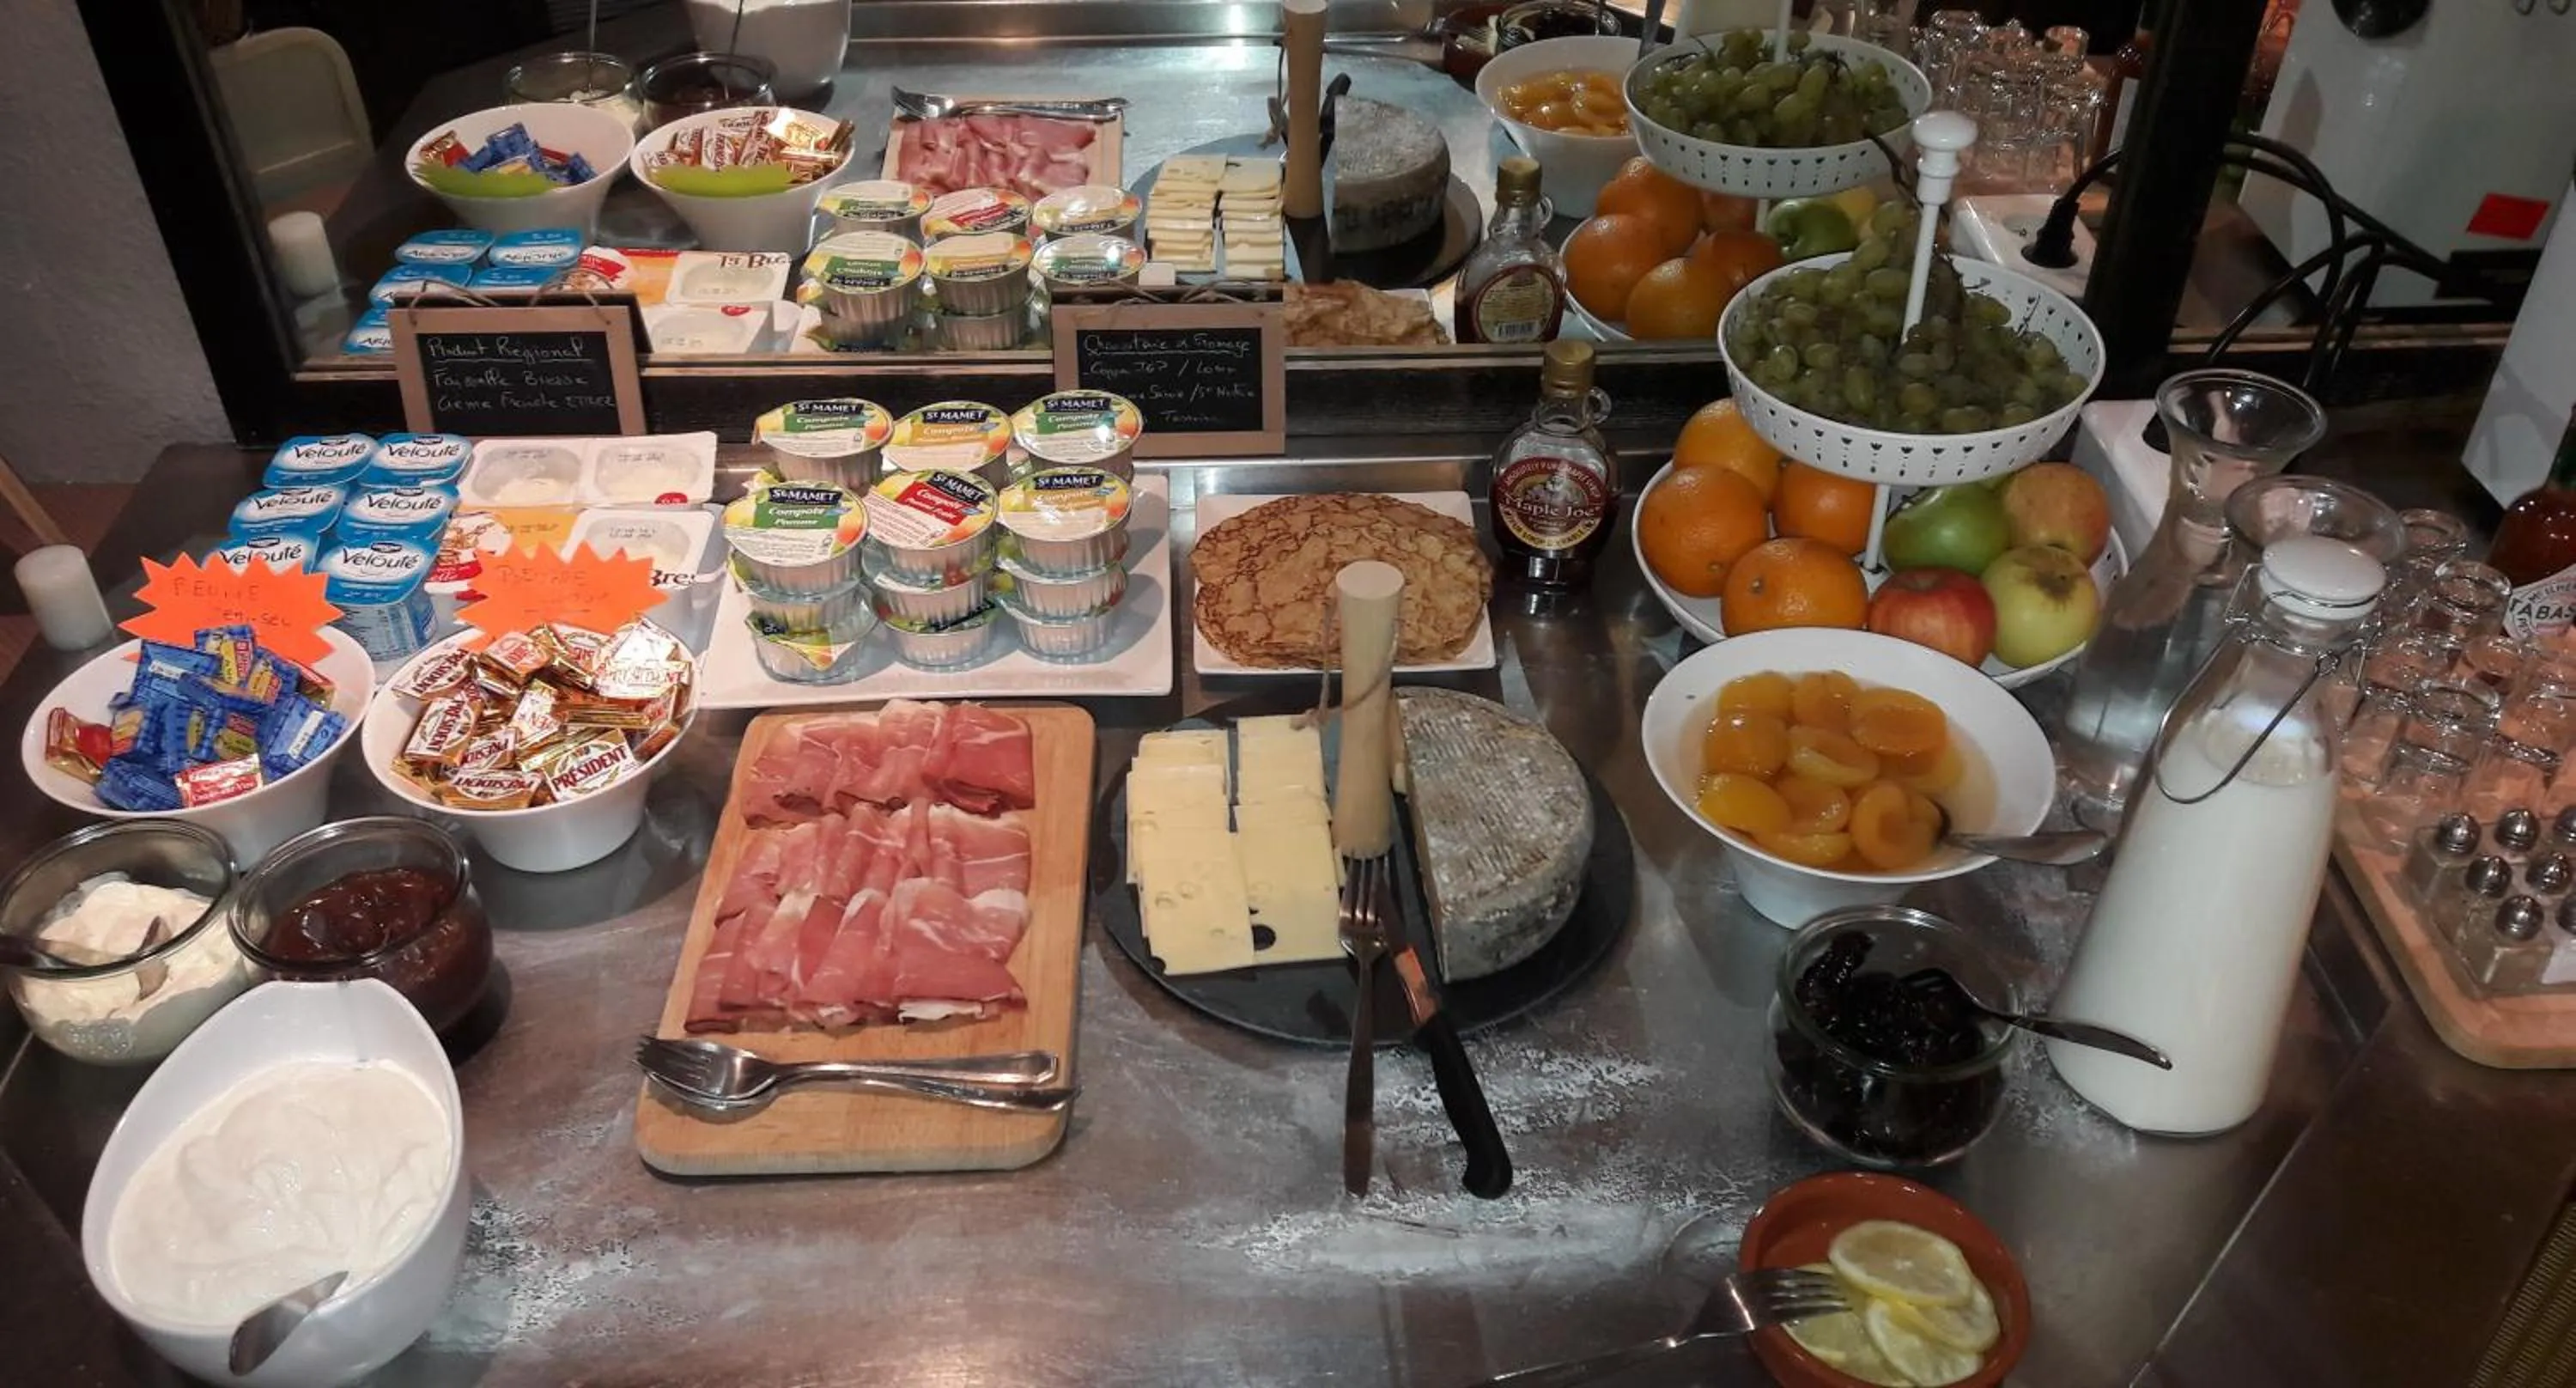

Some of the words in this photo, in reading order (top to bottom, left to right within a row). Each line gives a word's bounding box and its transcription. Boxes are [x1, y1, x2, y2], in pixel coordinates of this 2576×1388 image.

[812, 403, 857, 412] MAMET
[1061, 399, 1103, 408] MAMET
[940, 410, 982, 420] MAMET
[294, 443, 367, 460] Velouté
[387, 443, 460, 458] Velouté
[1053, 475, 1098, 486] MAMET
[787, 490, 836, 502] MAMET
[945, 478, 984, 501] MAMET
[255, 490, 333, 510] Velouté
[367, 494, 442, 509] Velouté
[769, 507, 825, 517] Compote
[343, 547, 418, 569] Velouté
